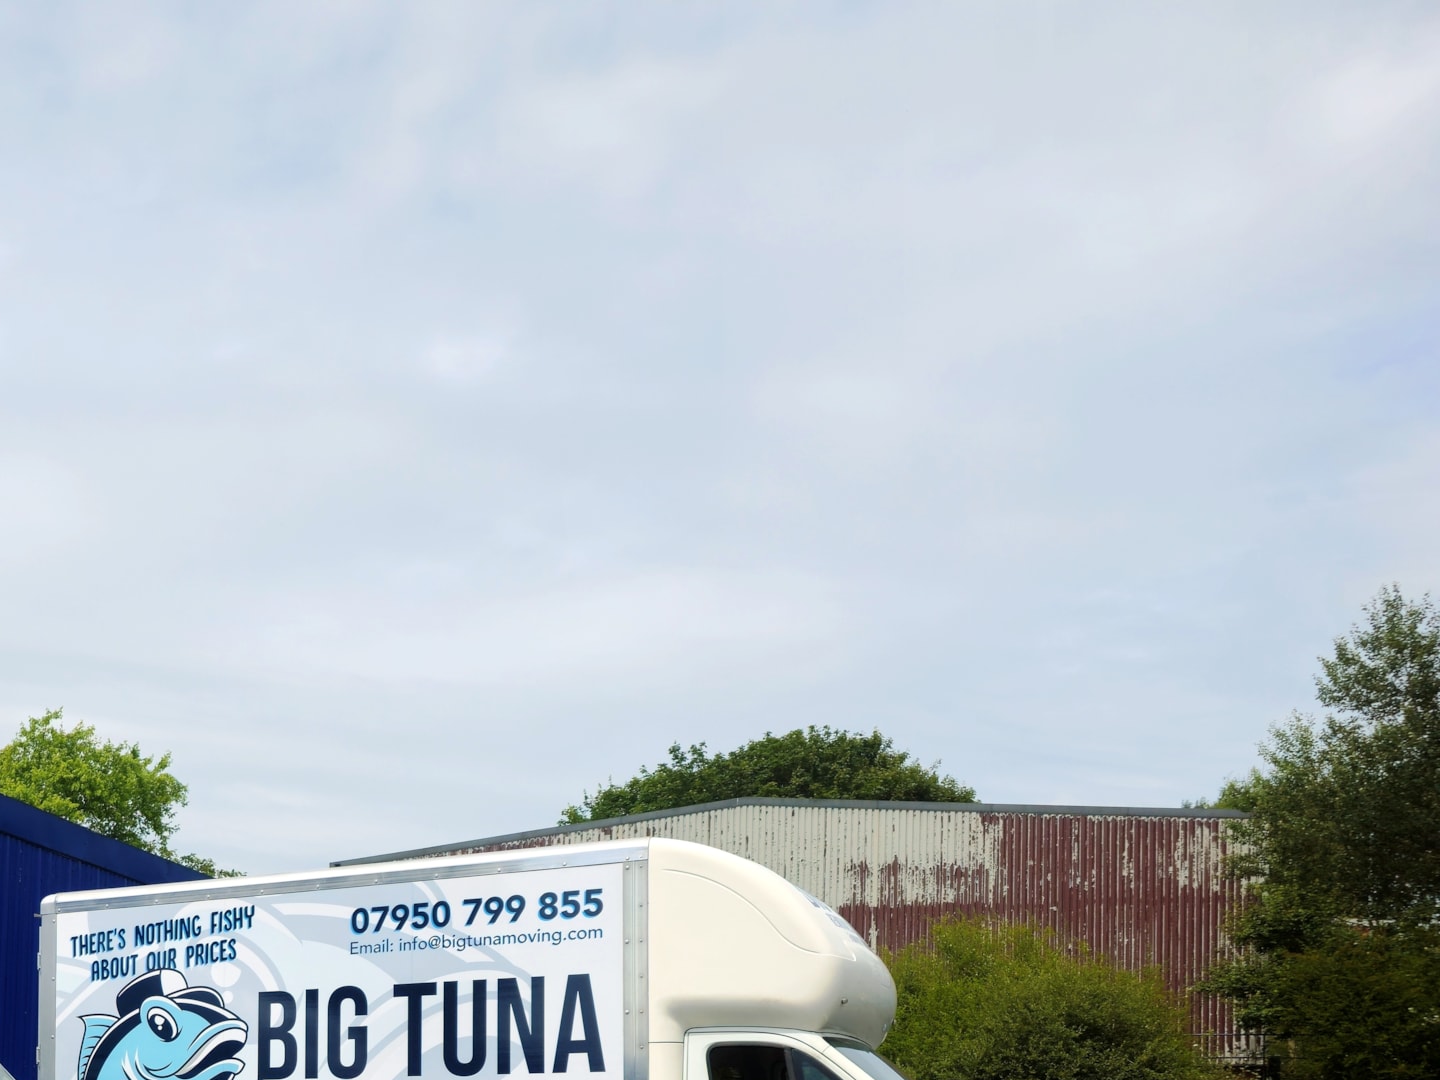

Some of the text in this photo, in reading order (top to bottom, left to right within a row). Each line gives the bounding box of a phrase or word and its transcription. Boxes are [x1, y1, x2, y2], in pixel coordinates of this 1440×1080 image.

[70, 905, 255, 958] THERE'S NOTHING FISHY
[350, 888, 604, 935] 07950 799 855
[91, 938, 237, 982] ABOUT OUR PRICES
[350, 927, 604, 955] Email: info@bigtunamoving.com
[258, 973, 606, 1080] BIG TUNA
